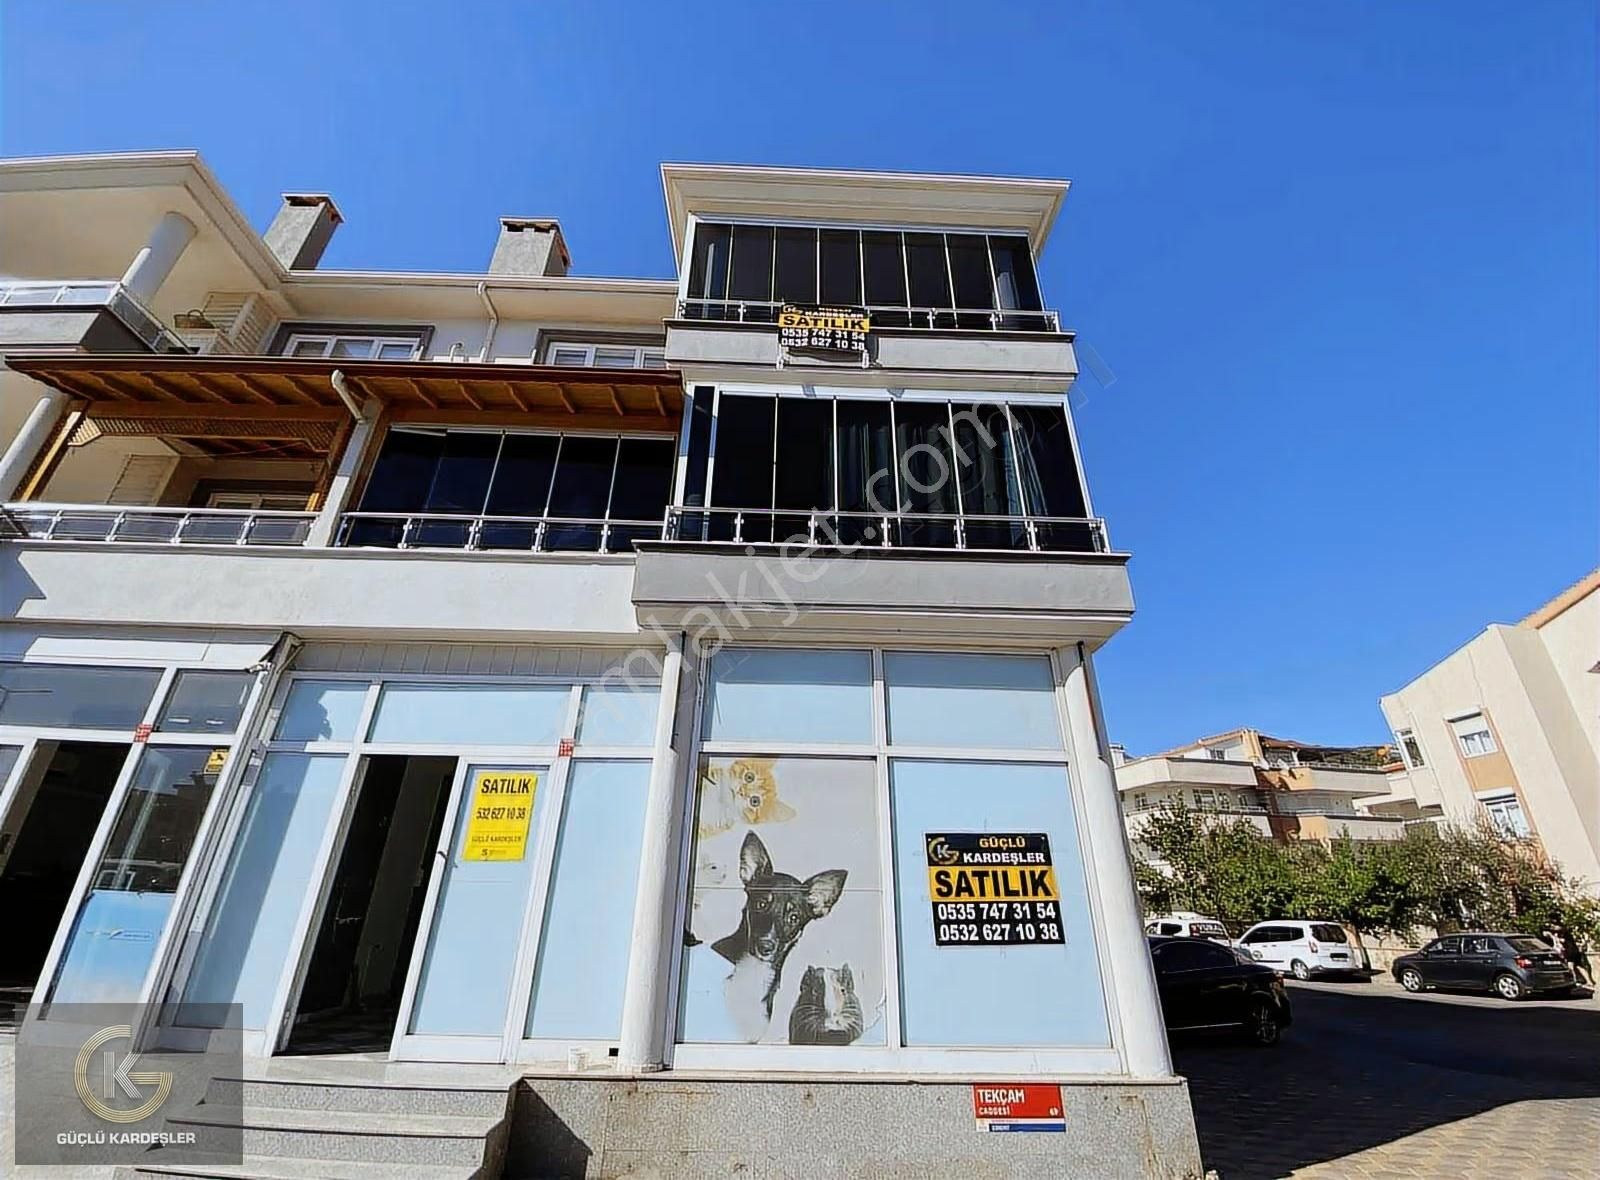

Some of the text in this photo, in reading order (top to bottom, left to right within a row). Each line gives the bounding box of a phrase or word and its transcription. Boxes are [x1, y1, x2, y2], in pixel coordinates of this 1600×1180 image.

[783, 315, 865, 330] SATILIK
[782, 328, 865, 341] 0535 747 31 54
[782, 337, 865, 350] 0532 627 10 38
[481, 779, 532, 793] SATILIK
[476, 807, 491, 819] 532
[491, 807, 506, 819] 627
[506, 807, 516, 819] 10
[979, 836, 1026, 850] GÜÇLÜ
[963, 852, 1046, 865] KARDEŞLER
[935, 870, 1053, 897] SATILIK
[938, 903, 1056, 920] 0535 747 31 54
[939, 923, 1059, 941] 0532 627 10 38
[977, 1089, 1025, 1105] TEKÇAM
